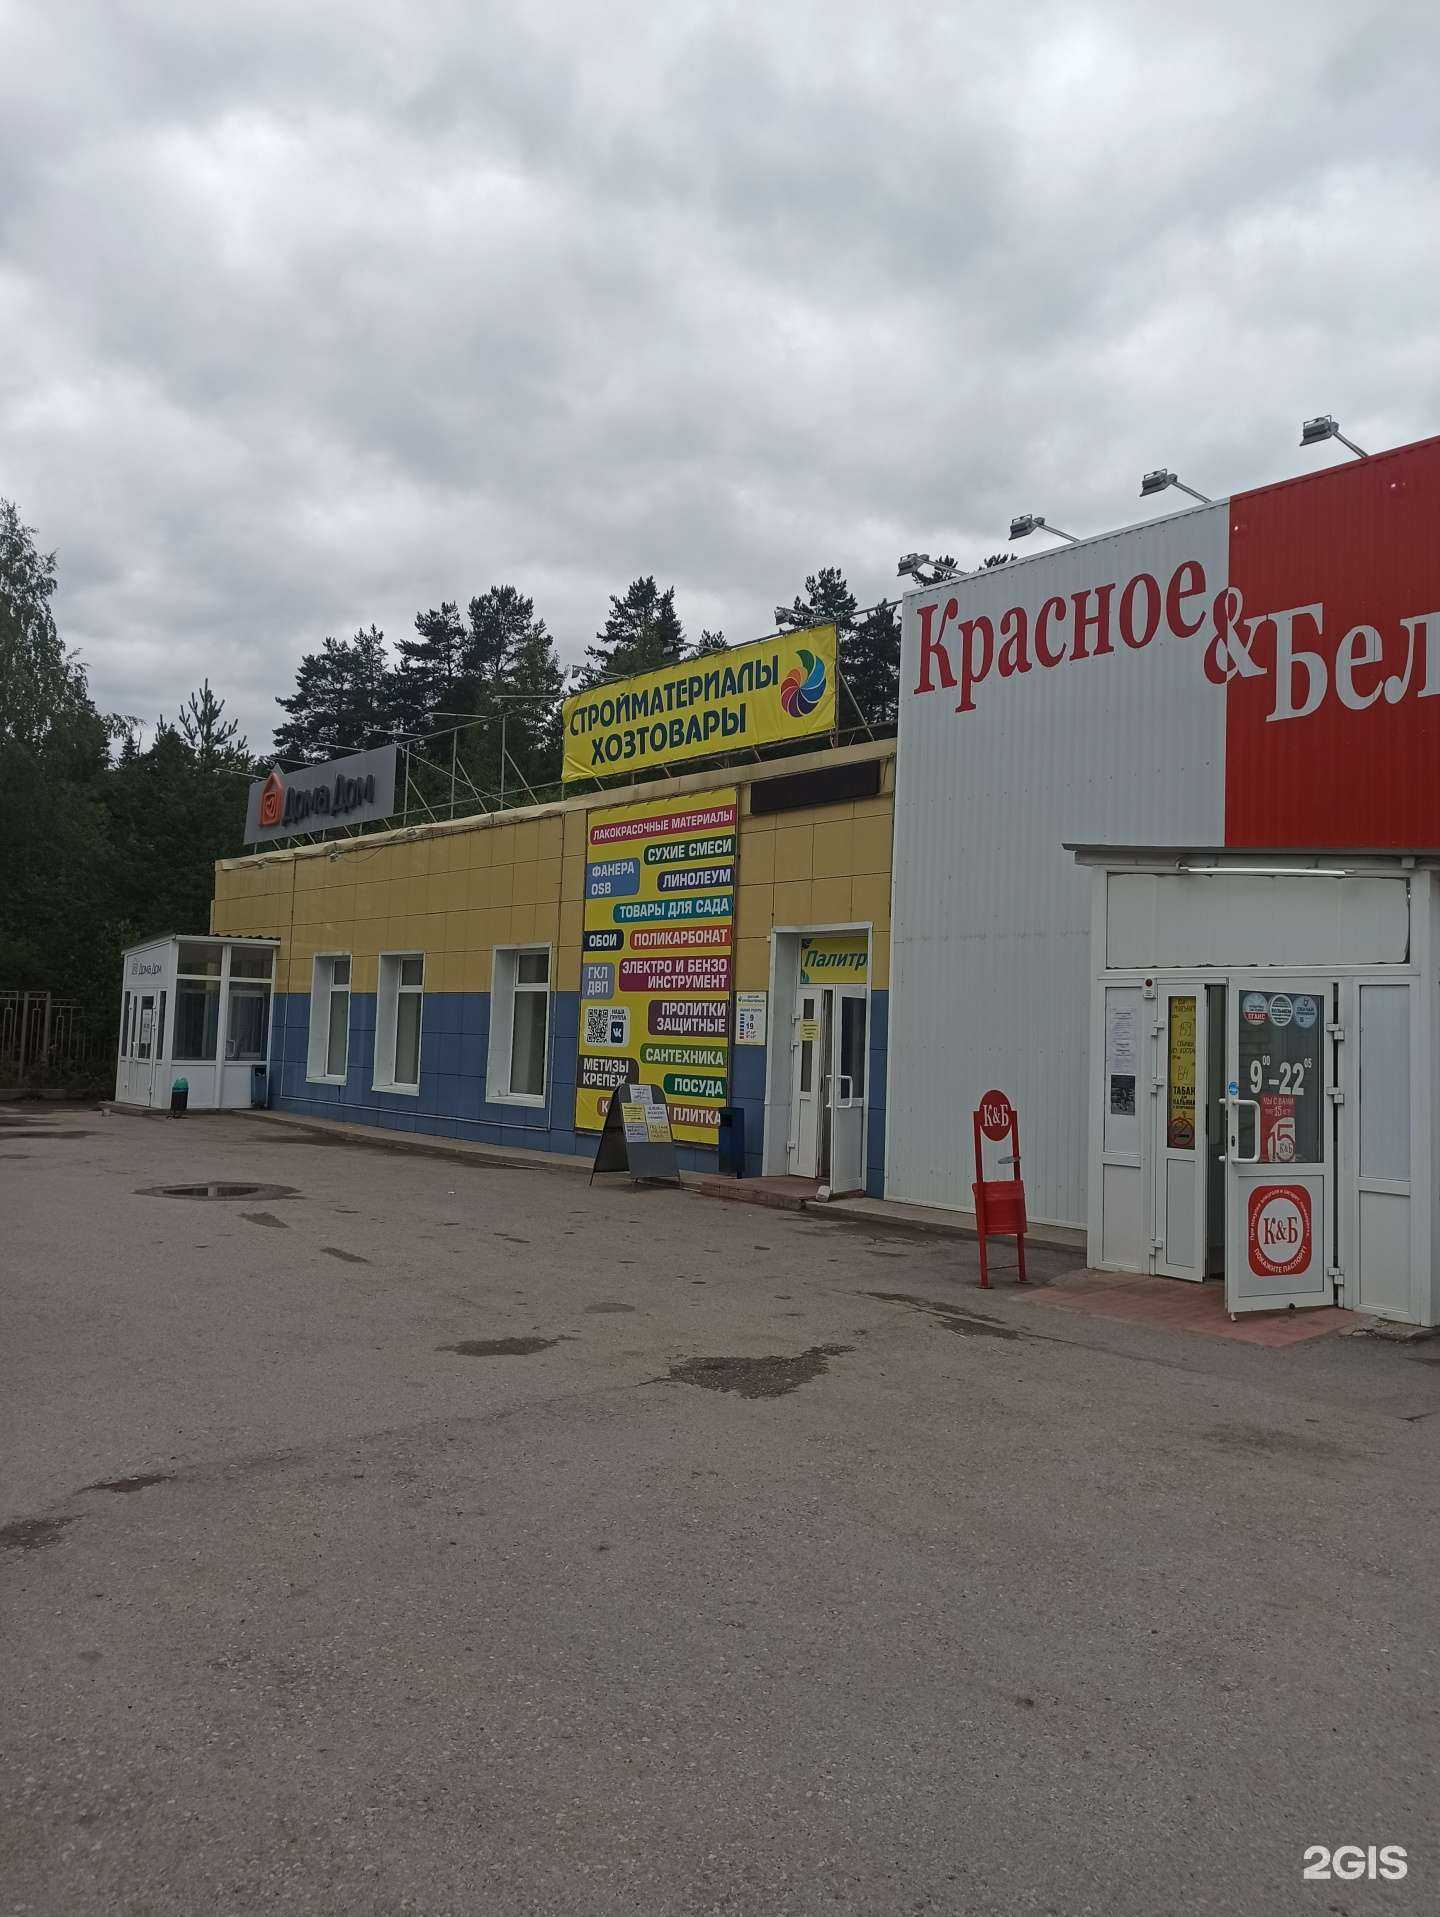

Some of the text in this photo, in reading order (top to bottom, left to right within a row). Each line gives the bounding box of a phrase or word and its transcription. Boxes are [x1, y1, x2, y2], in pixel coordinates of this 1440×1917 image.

[569, 655, 779, 736] СТРОЙМАТЕРИАЛЫ
[591, 703, 746, 765] ХОЗТОВАРЫ
[593, 810, 733, 840] ЛАКОКРАСОЧНЫЕ МАТЕРИАЛЫ
[648, 838, 732, 861] СУХИЕ СМЕСИ
[592, 862, 635, 877] ФАНЕРА
[662, 868, 731, 888] ЛИНОЛЕУМ
[591, 882, 612, 895] OSB
[620, 897, 729, 918] ТОВАРЫ ДЛЯ САДА
[589, 933, 617, 947] ОБОИ
[634, 929, 727, 946] ПОЛИКАРБОНАТ
[622, 959, 727, 974] ЭЛЕКТРО И БЕНЗО
[804, 950, 868, 971] Палитр
[588, 966, 608, 979] ГКЛ
[587, 980, 609, 995] ДВП
[648, 975, 727, 989] ИНСТРУМЕНТ
[661, 1002, 726, 1016] ПРОПИТКИ
[657, 1018, 726, 1033] ЗАЩИТНЫЕ
[645, 1048, 724, 1065] САНТЕХНИКА
[583, 1058, 629, 1073] МЕТИЗЫ
[675, 1077, 723, 1096] ПОСУДА
[673, 1107, 721, 1125] ПЛИТКА
[983, 1104, 1009, 1127] К&Б
[1263, 1216, 1299, 1245] К&Б
